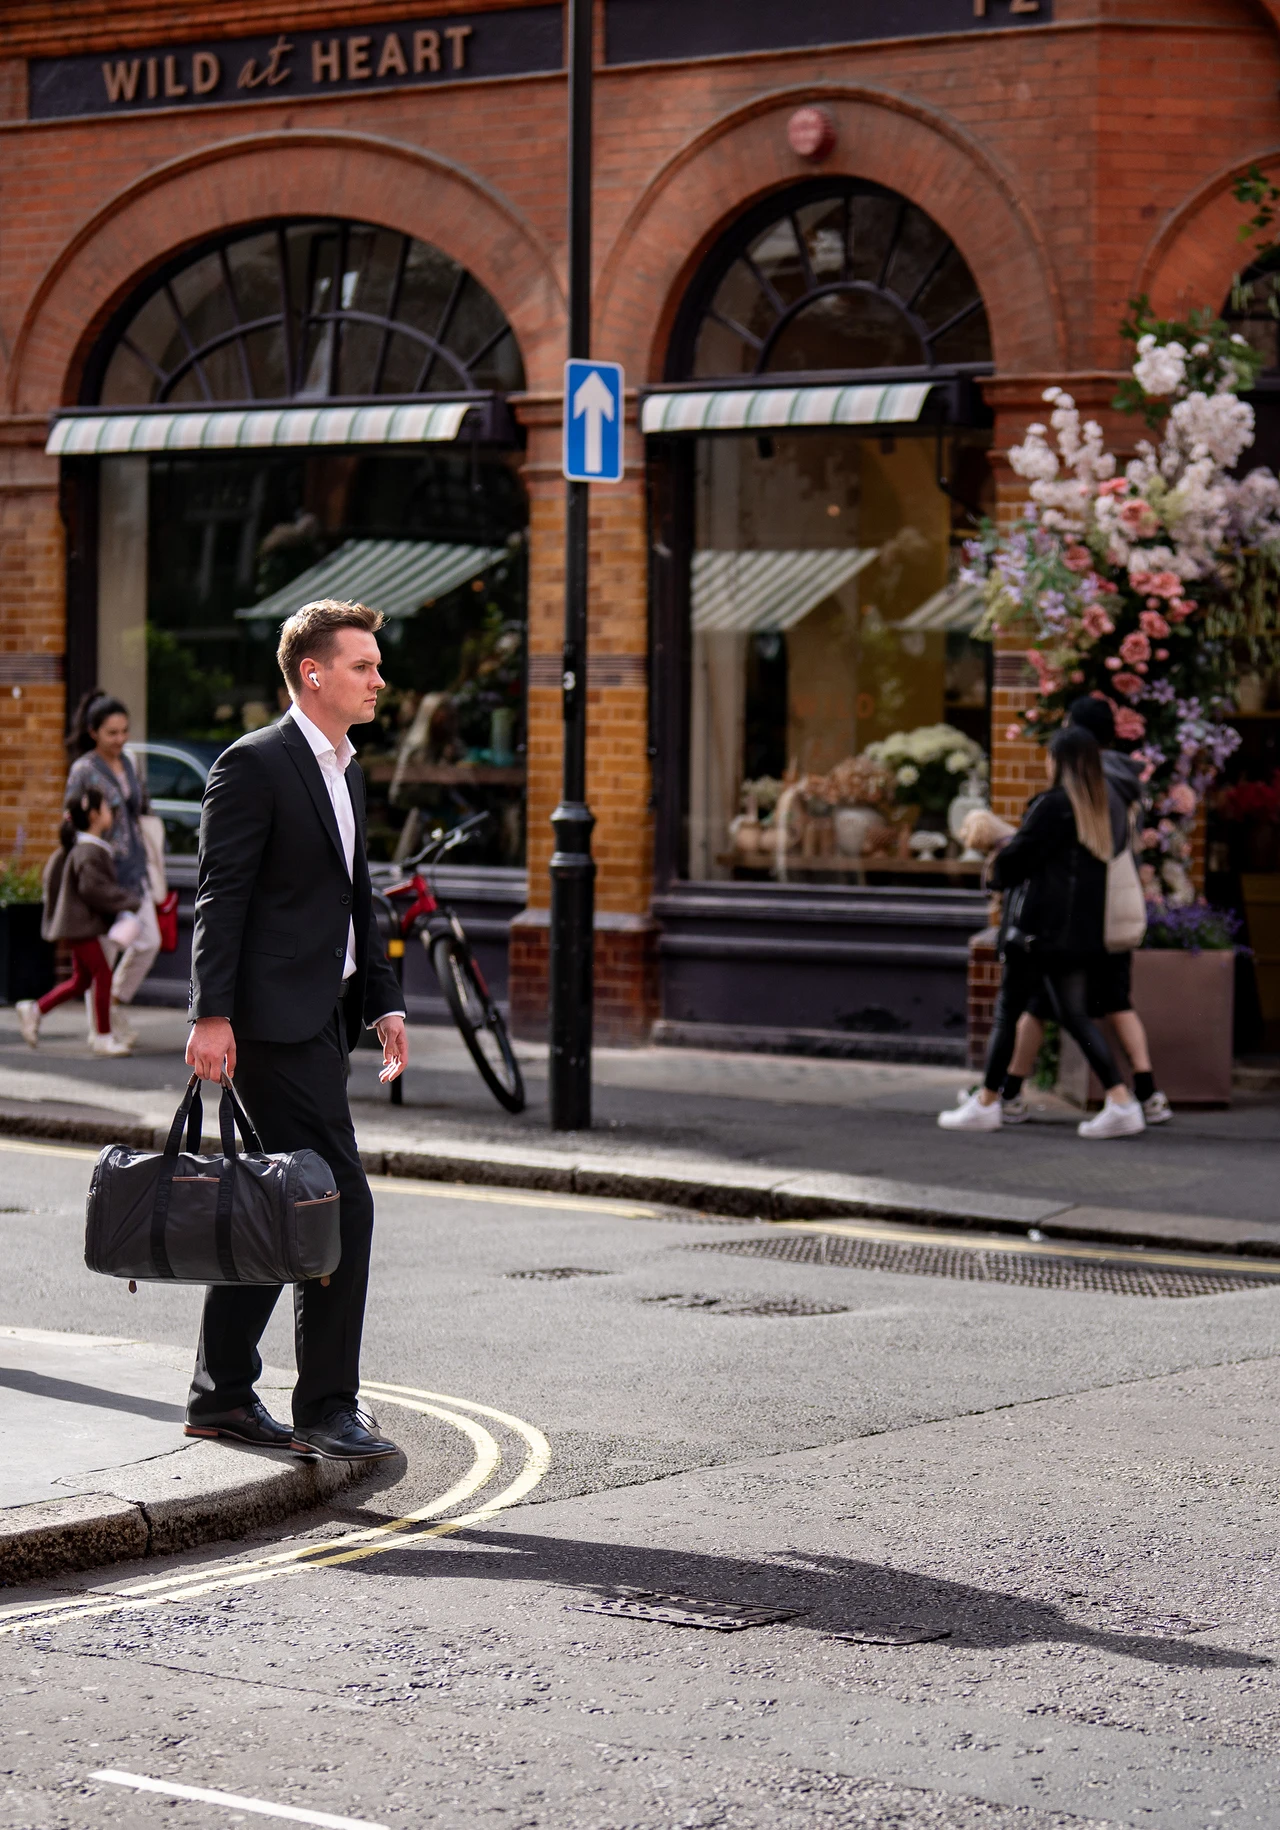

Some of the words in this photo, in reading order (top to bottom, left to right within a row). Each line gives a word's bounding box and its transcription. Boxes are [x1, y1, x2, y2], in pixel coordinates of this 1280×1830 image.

[102, 52, 220, 103] WILD
[237, 35, 294, 90] at
[311, 25, 473, 83] HEART
